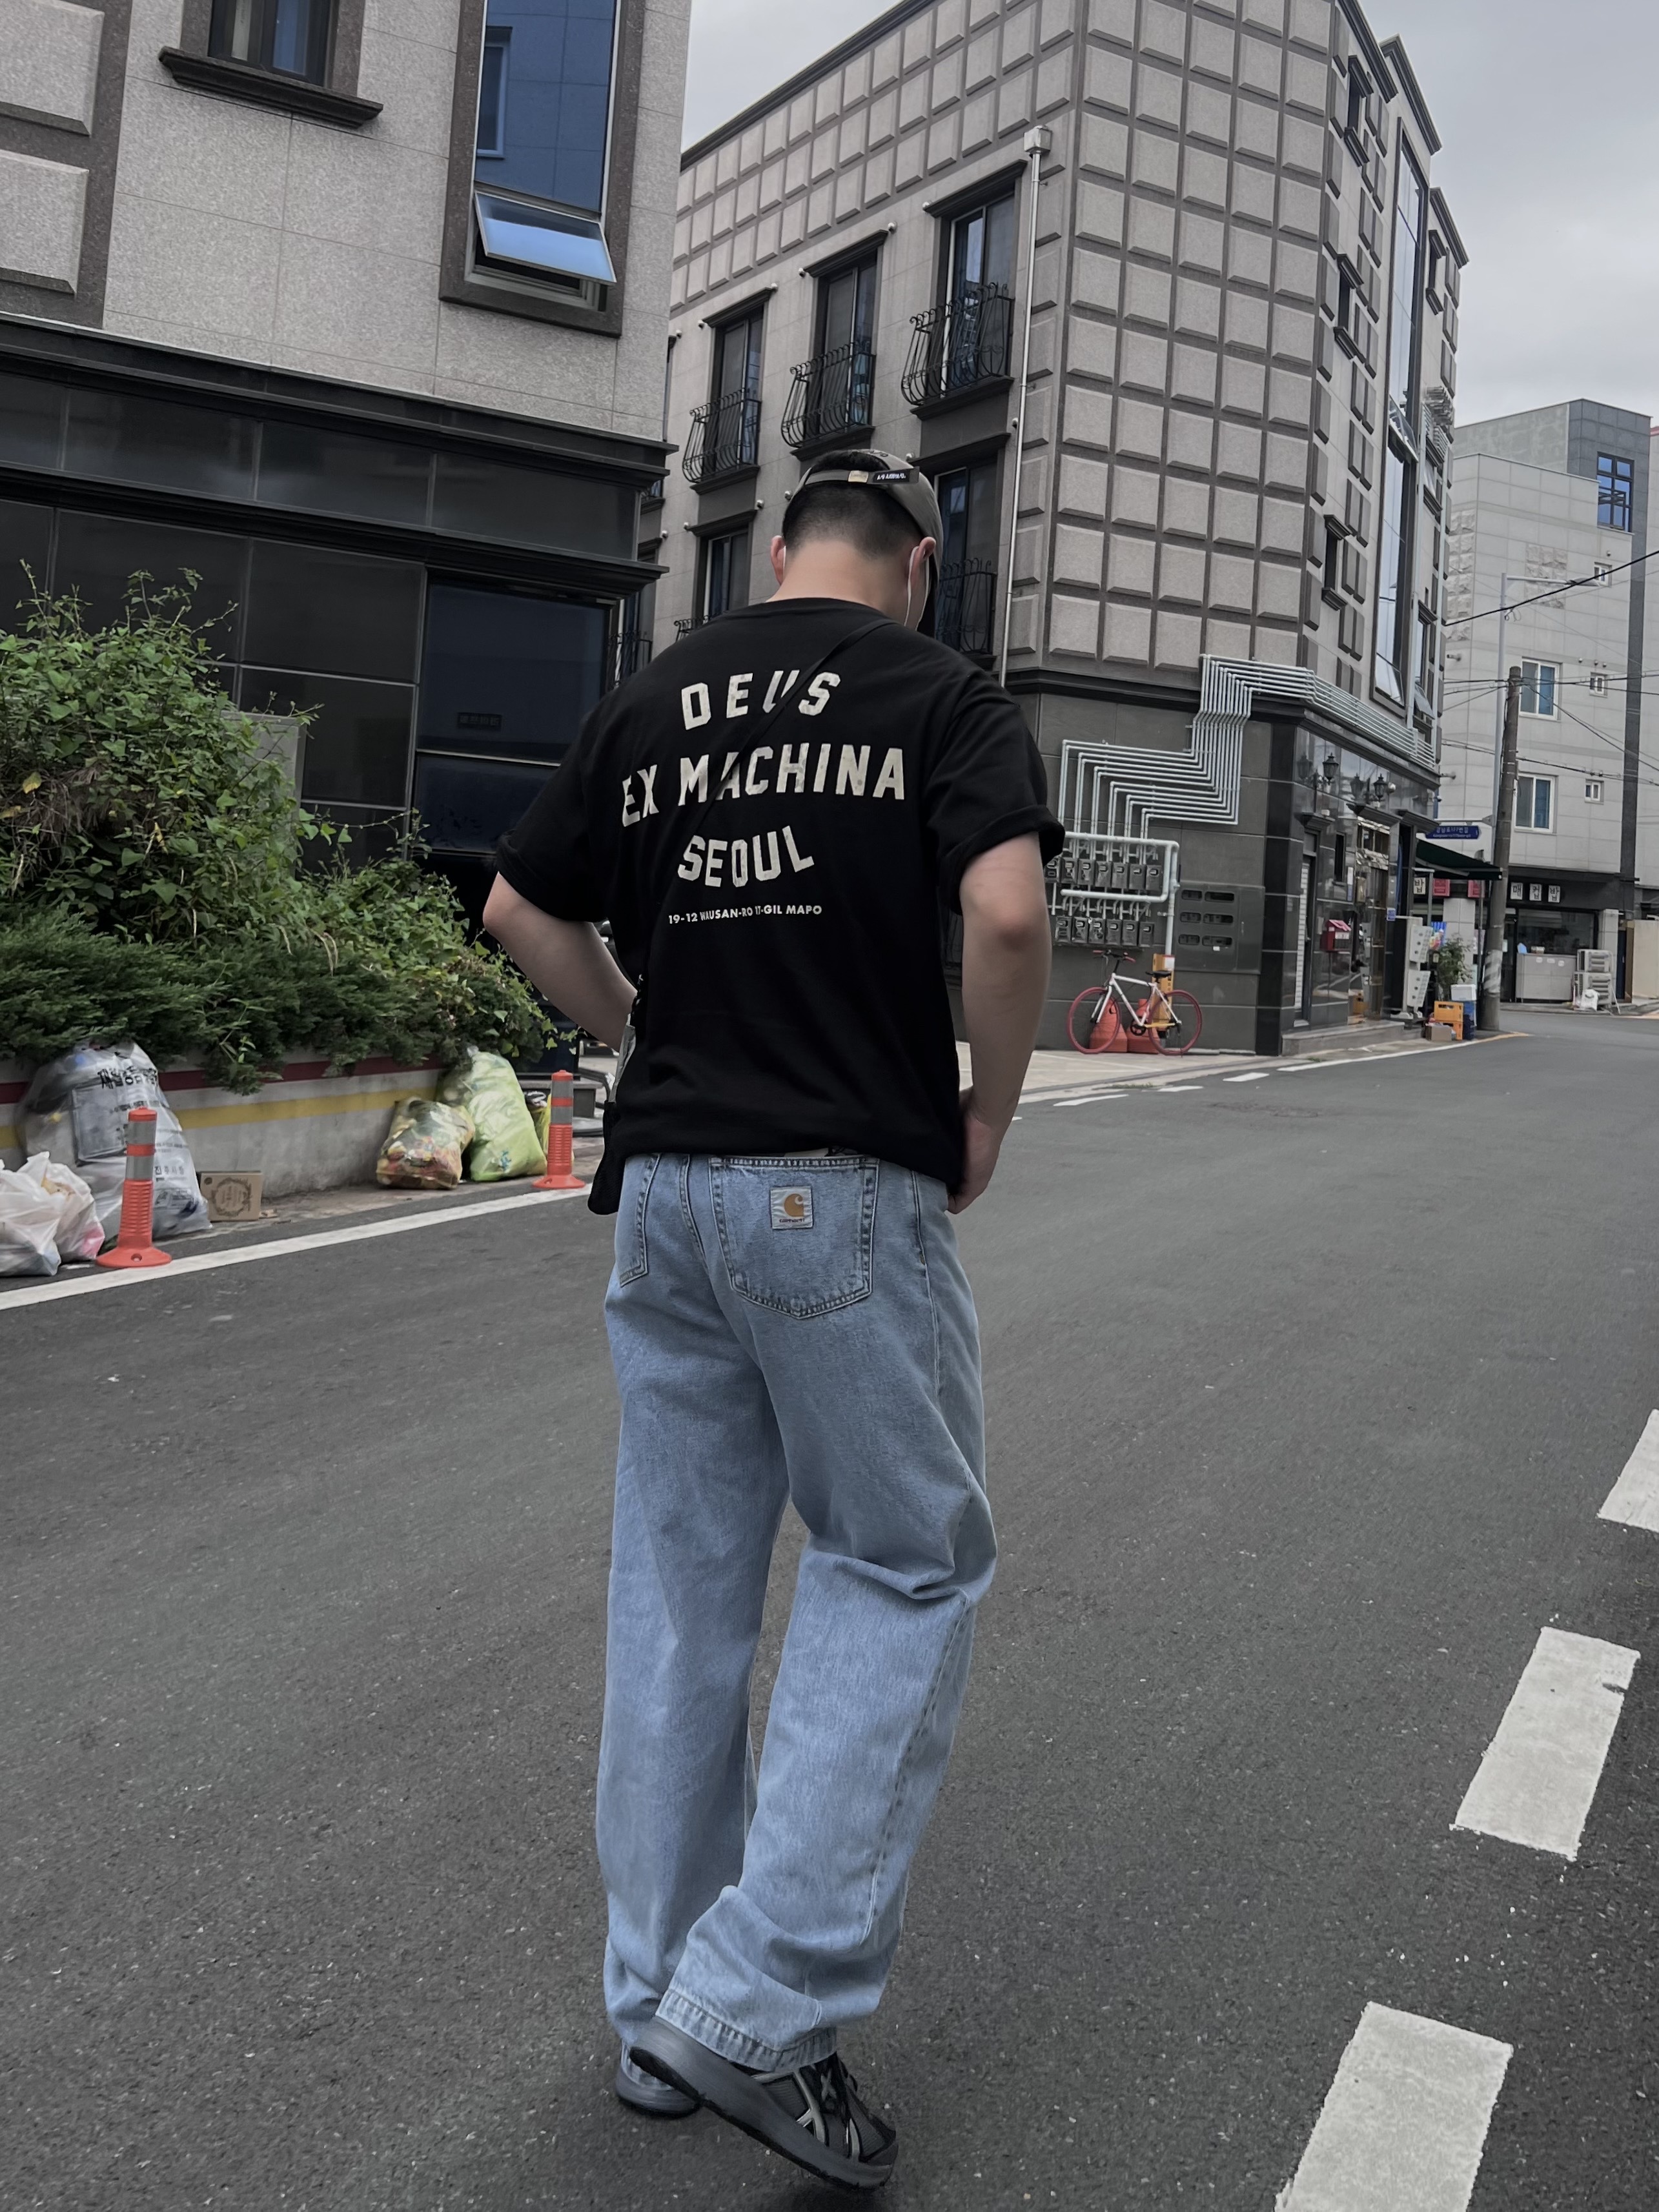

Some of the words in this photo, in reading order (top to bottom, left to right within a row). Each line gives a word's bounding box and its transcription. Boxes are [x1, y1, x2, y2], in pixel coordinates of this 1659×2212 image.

[682, 670, 840, 730] DEUS
[622, 765, 659, 827] EX
[678, 743, 904, 806] MACHINA
[678, 826, 814, 887] SEOUL
[669, 913, 698, 924] 19-12
[700, 907, 753, 921] WAUSAN-RO
[786, 905, 822, 915] MAPO
